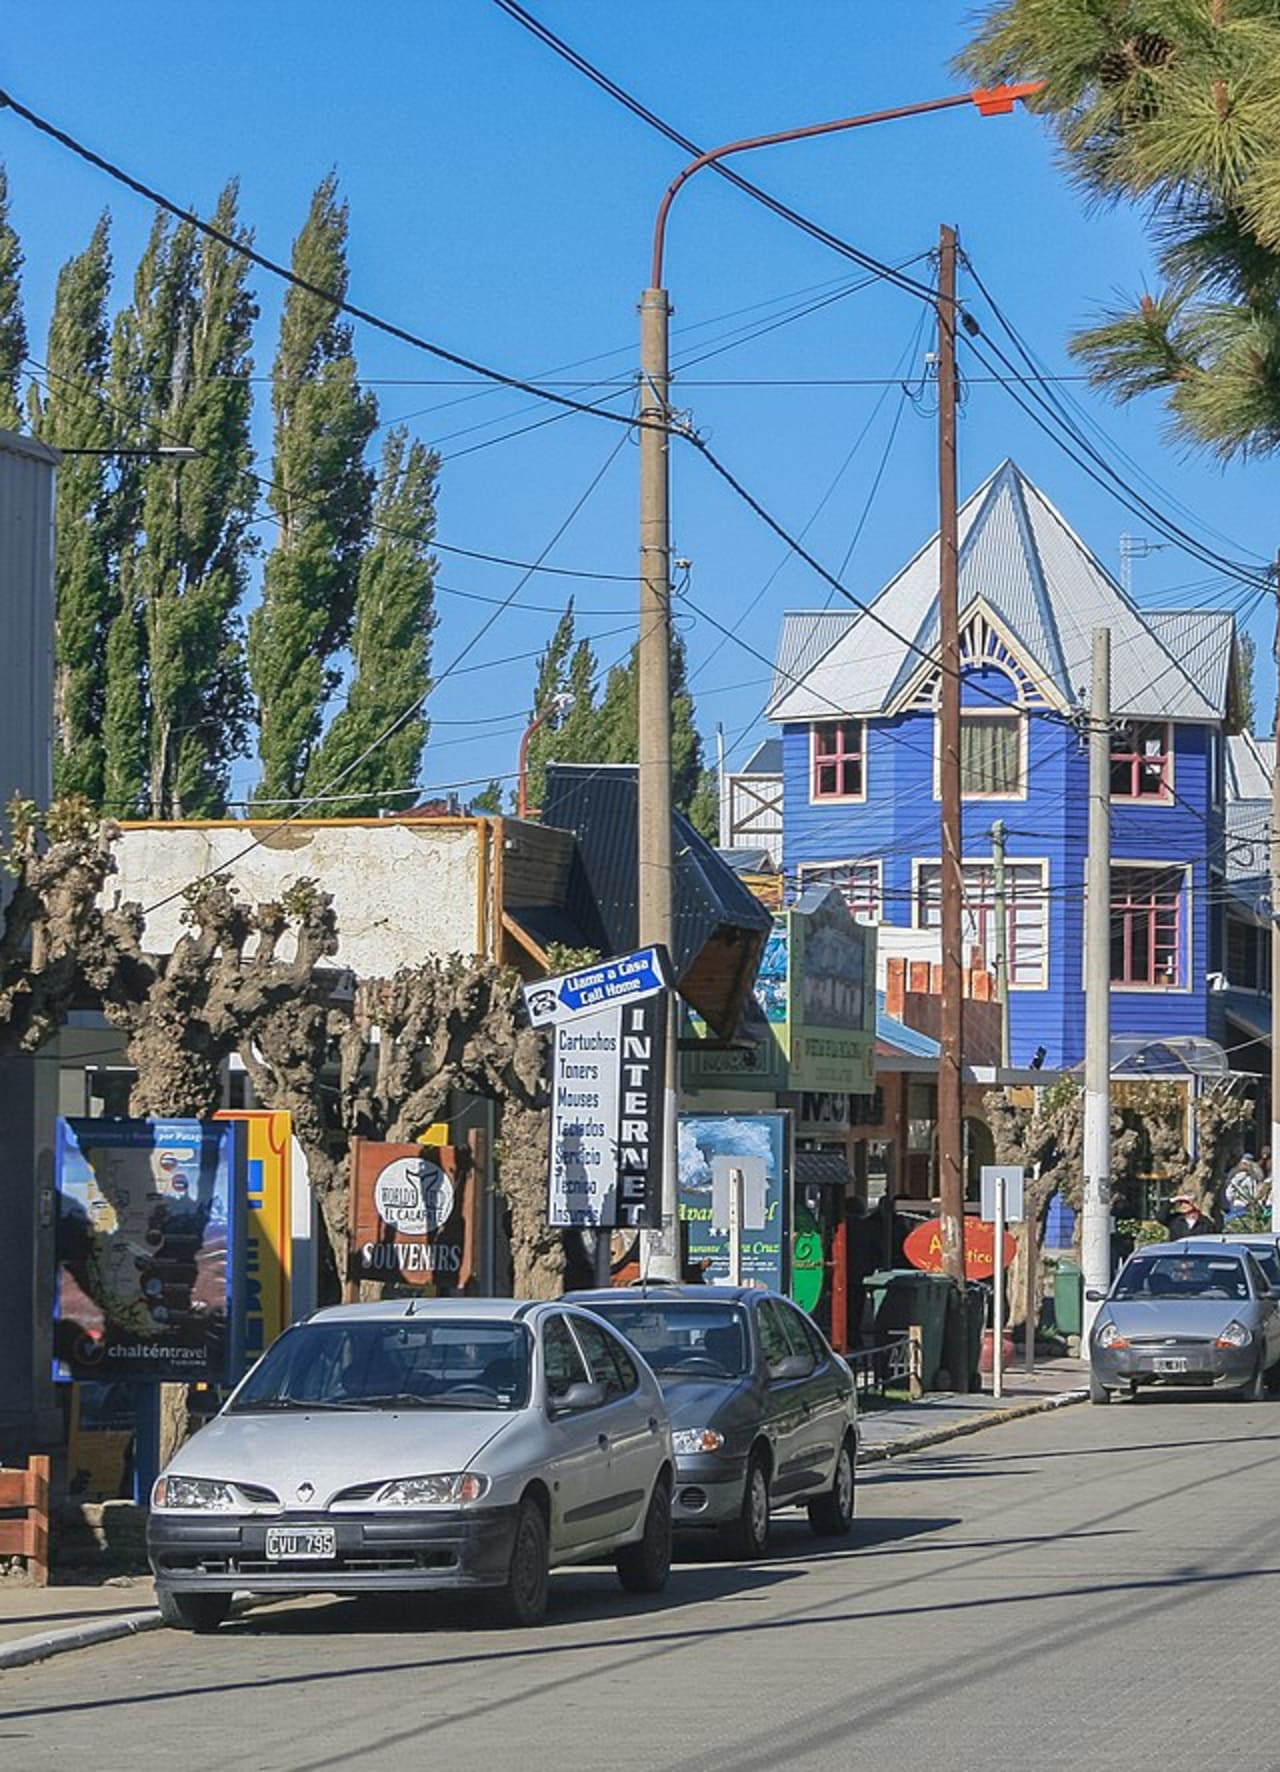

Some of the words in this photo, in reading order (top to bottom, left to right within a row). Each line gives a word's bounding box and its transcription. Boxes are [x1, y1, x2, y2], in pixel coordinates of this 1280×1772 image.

[607, 969, 617, 980] a
[618, 959, 649, 976] Casa
[580, 985, 604, 1005] Call
[605, 978, 641, 997] Home
[559, 1030, 617, 1051] Cartuchos
[559, 1057, 599, 1079] Toners
[557, 1086, 599, 1108] Mouses
[556, 1115, 605, 1137] Teclados
[620, 1008, 652, 1226] INTERNET
[362, 1242, 461, 1272] SOUVENIRS
[269, 1535, 297, 1553] CVU
[305, 1535, 333, 1553] 795
